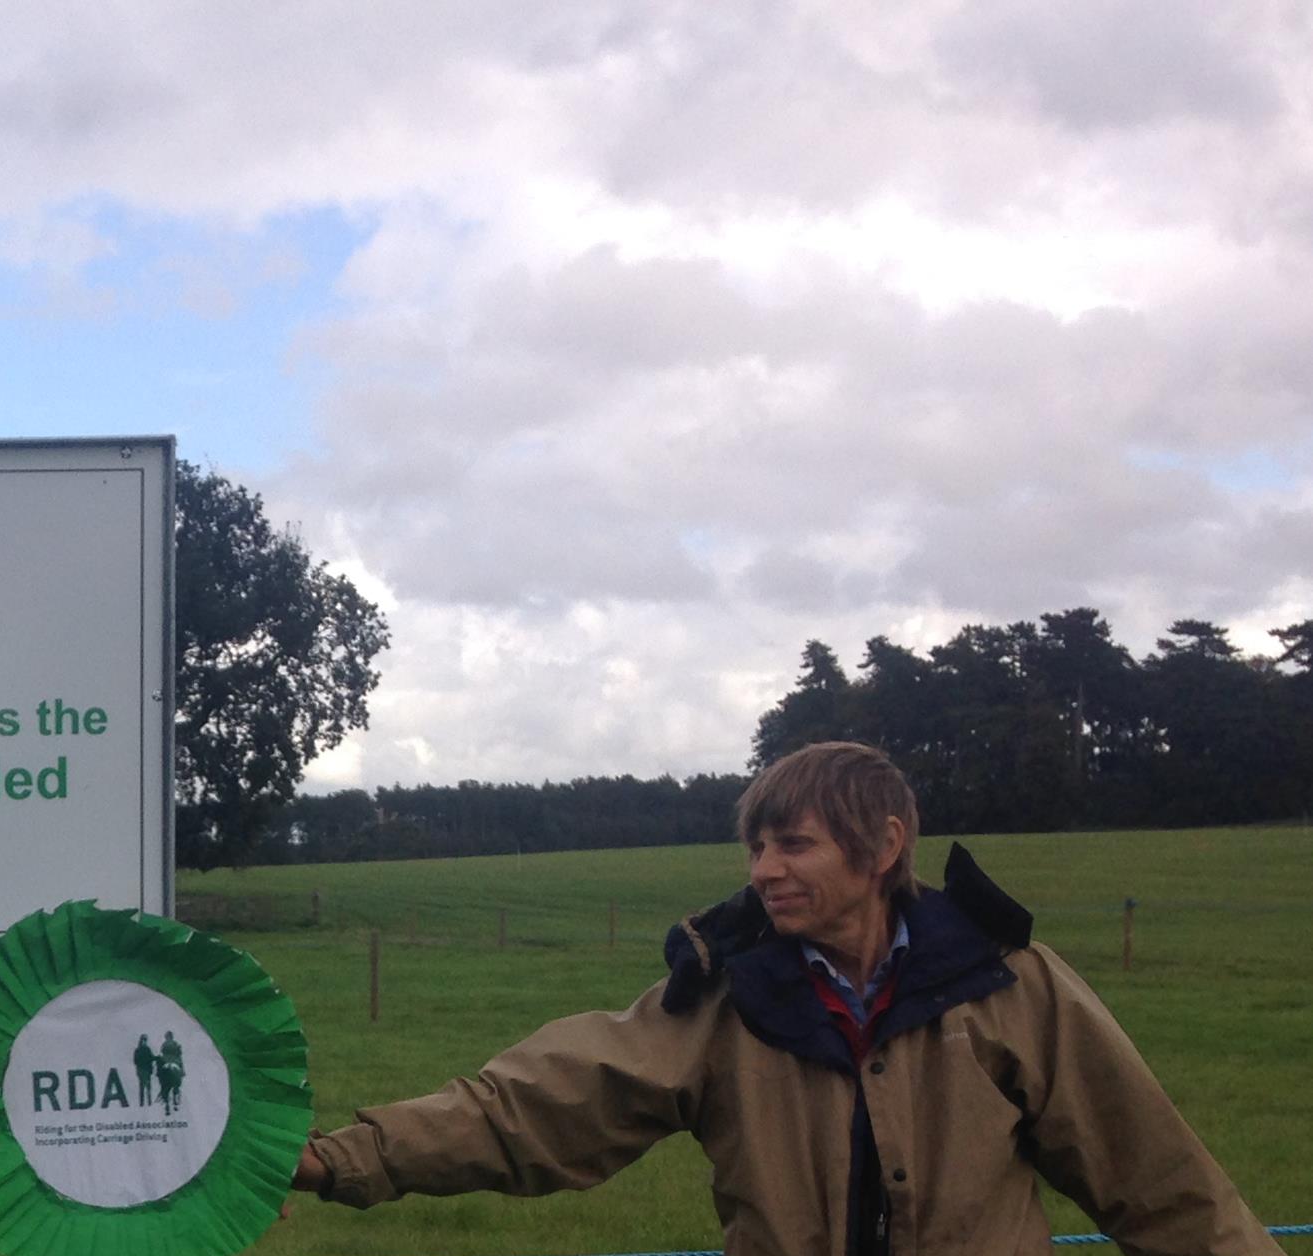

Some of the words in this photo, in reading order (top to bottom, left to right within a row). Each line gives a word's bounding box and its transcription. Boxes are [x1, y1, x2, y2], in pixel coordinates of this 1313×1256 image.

[36, 699, 109, 737] the
[32, 1067, 130, 1112] RDA
[35, 1125, 63, 1136] Riding
[64, 1124, 77, 1133] for
[78, 1123, 94, 1132] the
[95, 1121, 134, 1131] Disabled
[135, 1119, 188, 1129] Association
[35, 1135, 96, 1147] Incorporating
[97, 1134, 134, 1144] Carriage
[135, 1132, 168, 1143] Driving
